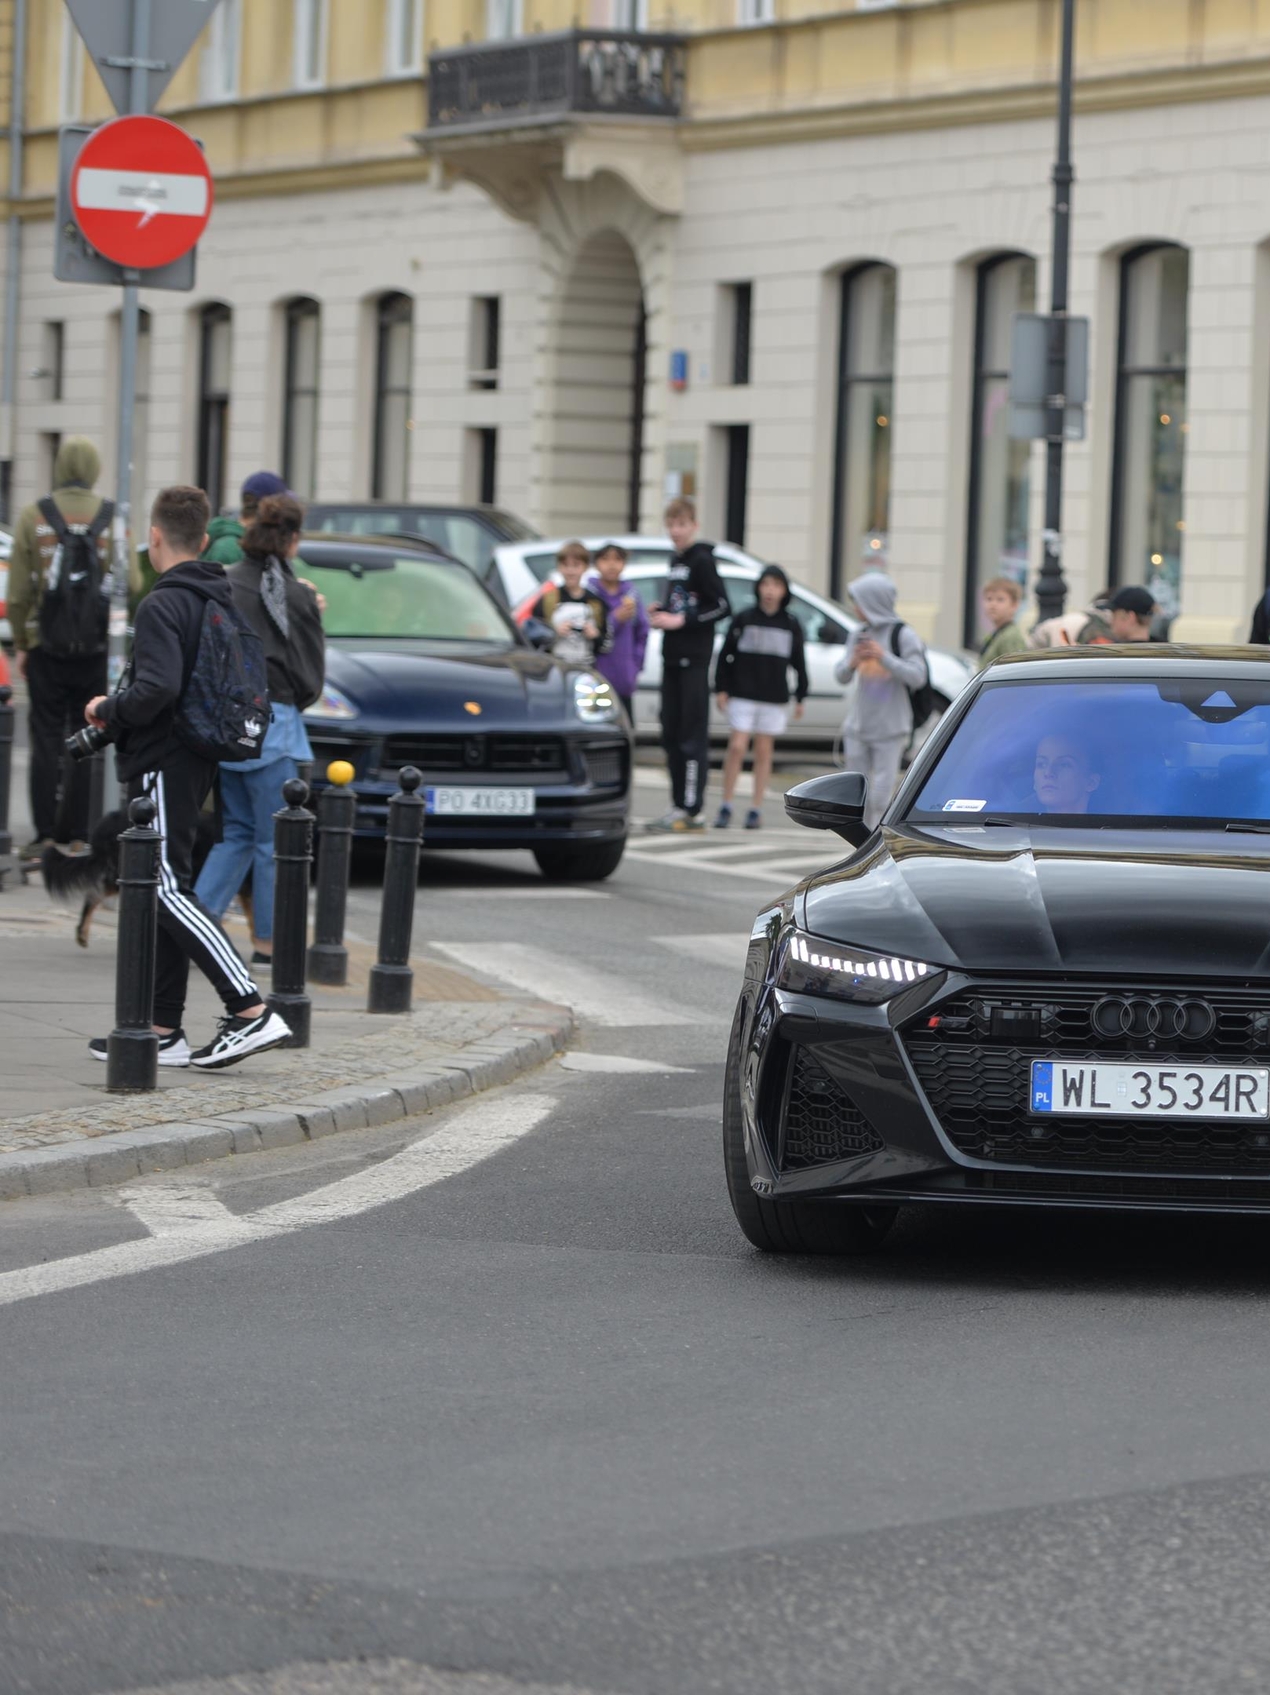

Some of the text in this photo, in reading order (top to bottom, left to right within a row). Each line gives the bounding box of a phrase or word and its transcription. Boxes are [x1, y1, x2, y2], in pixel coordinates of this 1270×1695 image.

[1035, 1091, 1050, 1104] PL
[1062, 1068, 1259, 1113] WL 3534R
